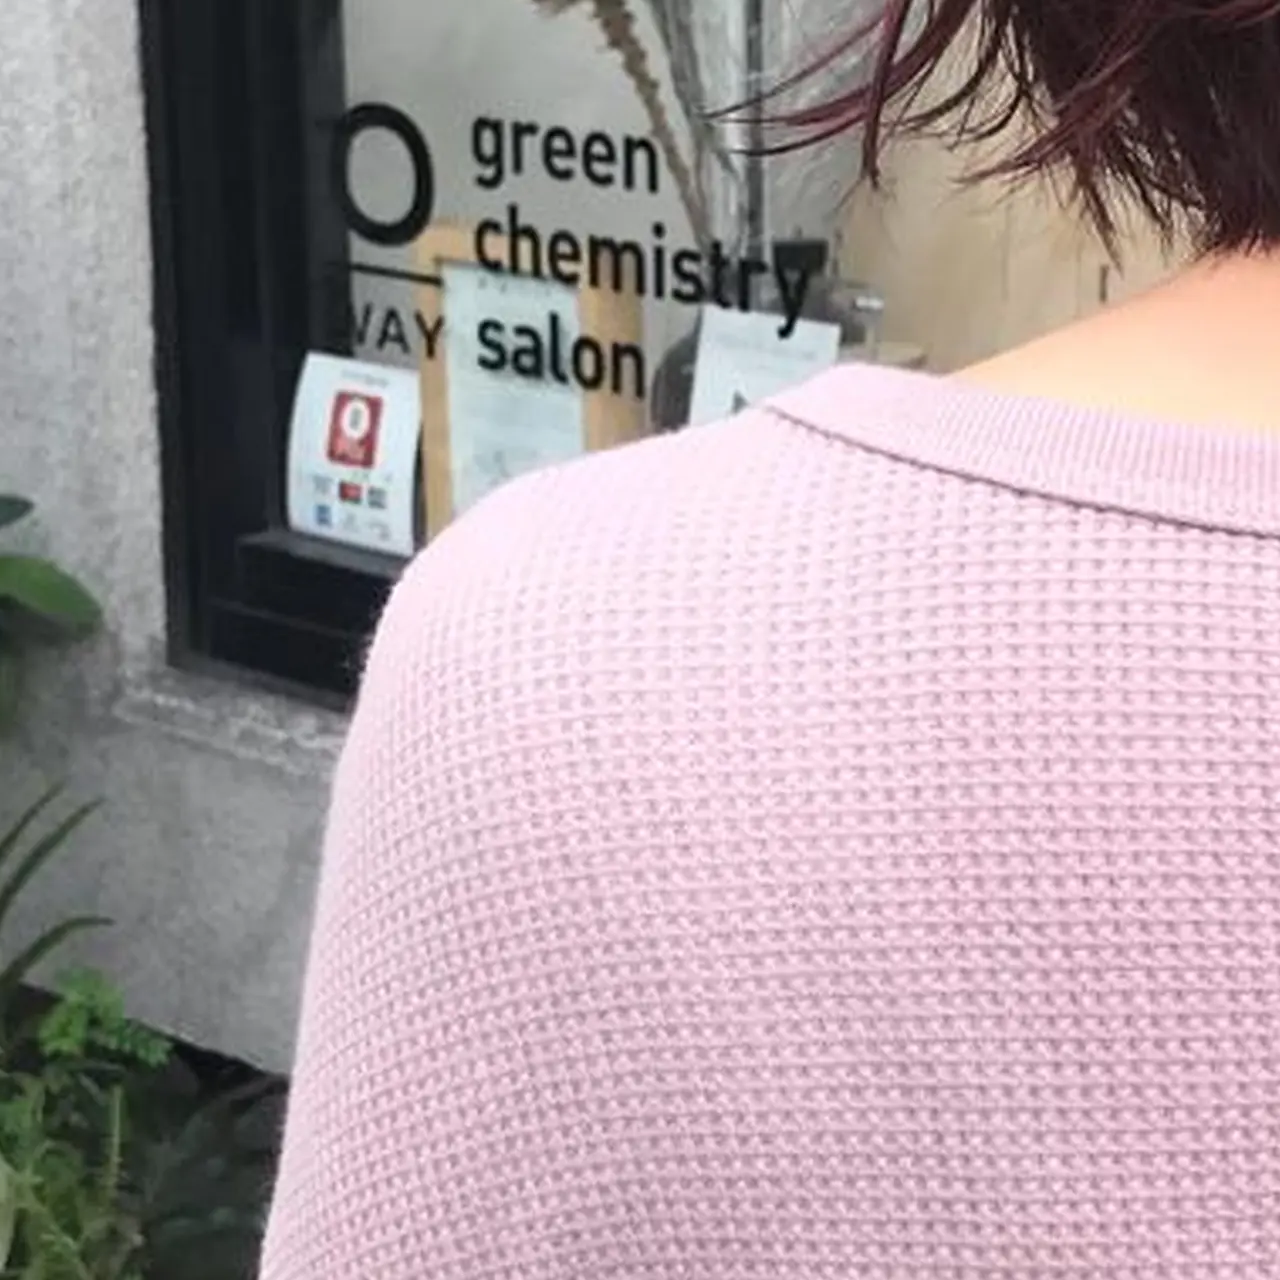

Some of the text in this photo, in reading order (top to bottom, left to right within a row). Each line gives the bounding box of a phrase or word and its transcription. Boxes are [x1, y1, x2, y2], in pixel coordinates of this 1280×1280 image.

[472, 116, 658, 193] green
[474, 203, 812, 340] chemistry
[476, 310, 646, 409] salon
